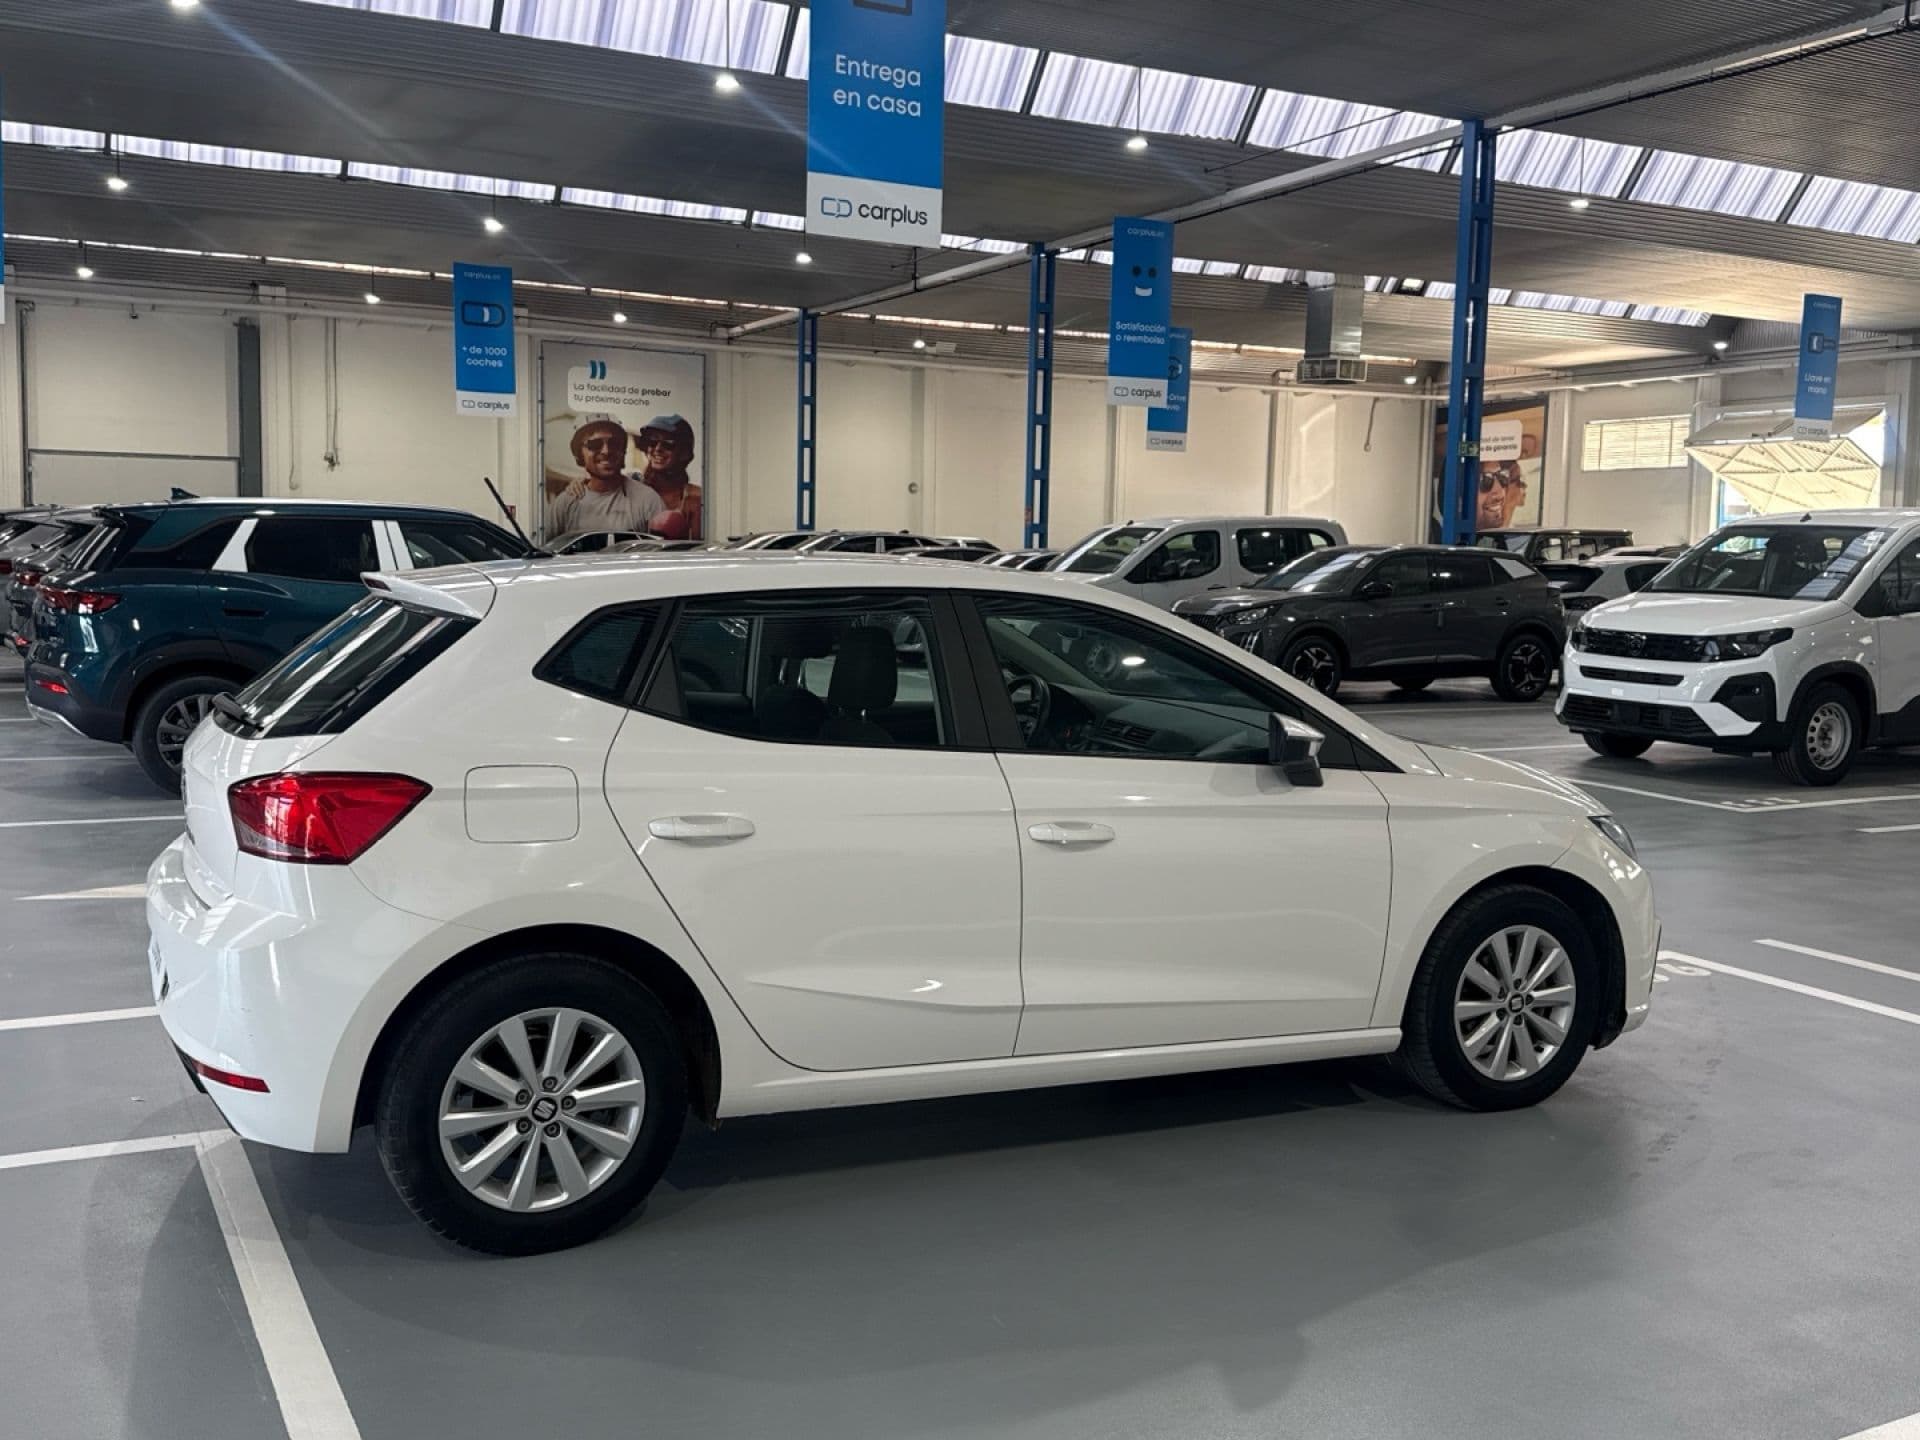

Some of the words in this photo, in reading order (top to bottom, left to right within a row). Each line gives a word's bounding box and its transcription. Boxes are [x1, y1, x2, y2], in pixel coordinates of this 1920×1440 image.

[835, 54, 921, 88] Entrega
[833, 89, 861, 108] en
[867, 94, 921, 117] casa
[858, 203, 928, 228] carplus
[1115, 321, 1166, 333] Satisfacción
[1115, 334, 1122, 342] o
[1123, 334, 1165, 345] reembolso
[469, 345, 482, 355] de
[485, 346, 507, 356] 1000
[466, 357, 503, 368] coches
[586, 383, 627, 394] facilidad
[628, 386, 640, 394] de
[641, 387, 671, 397] probar
[1131, 387, 1162, 401] carplus
[477, 400, 510, 411] carplus
[574, 393, 583, 401] tu
[585, 394, 621, 405] próximo
[623, 397, 650, 406] coche
